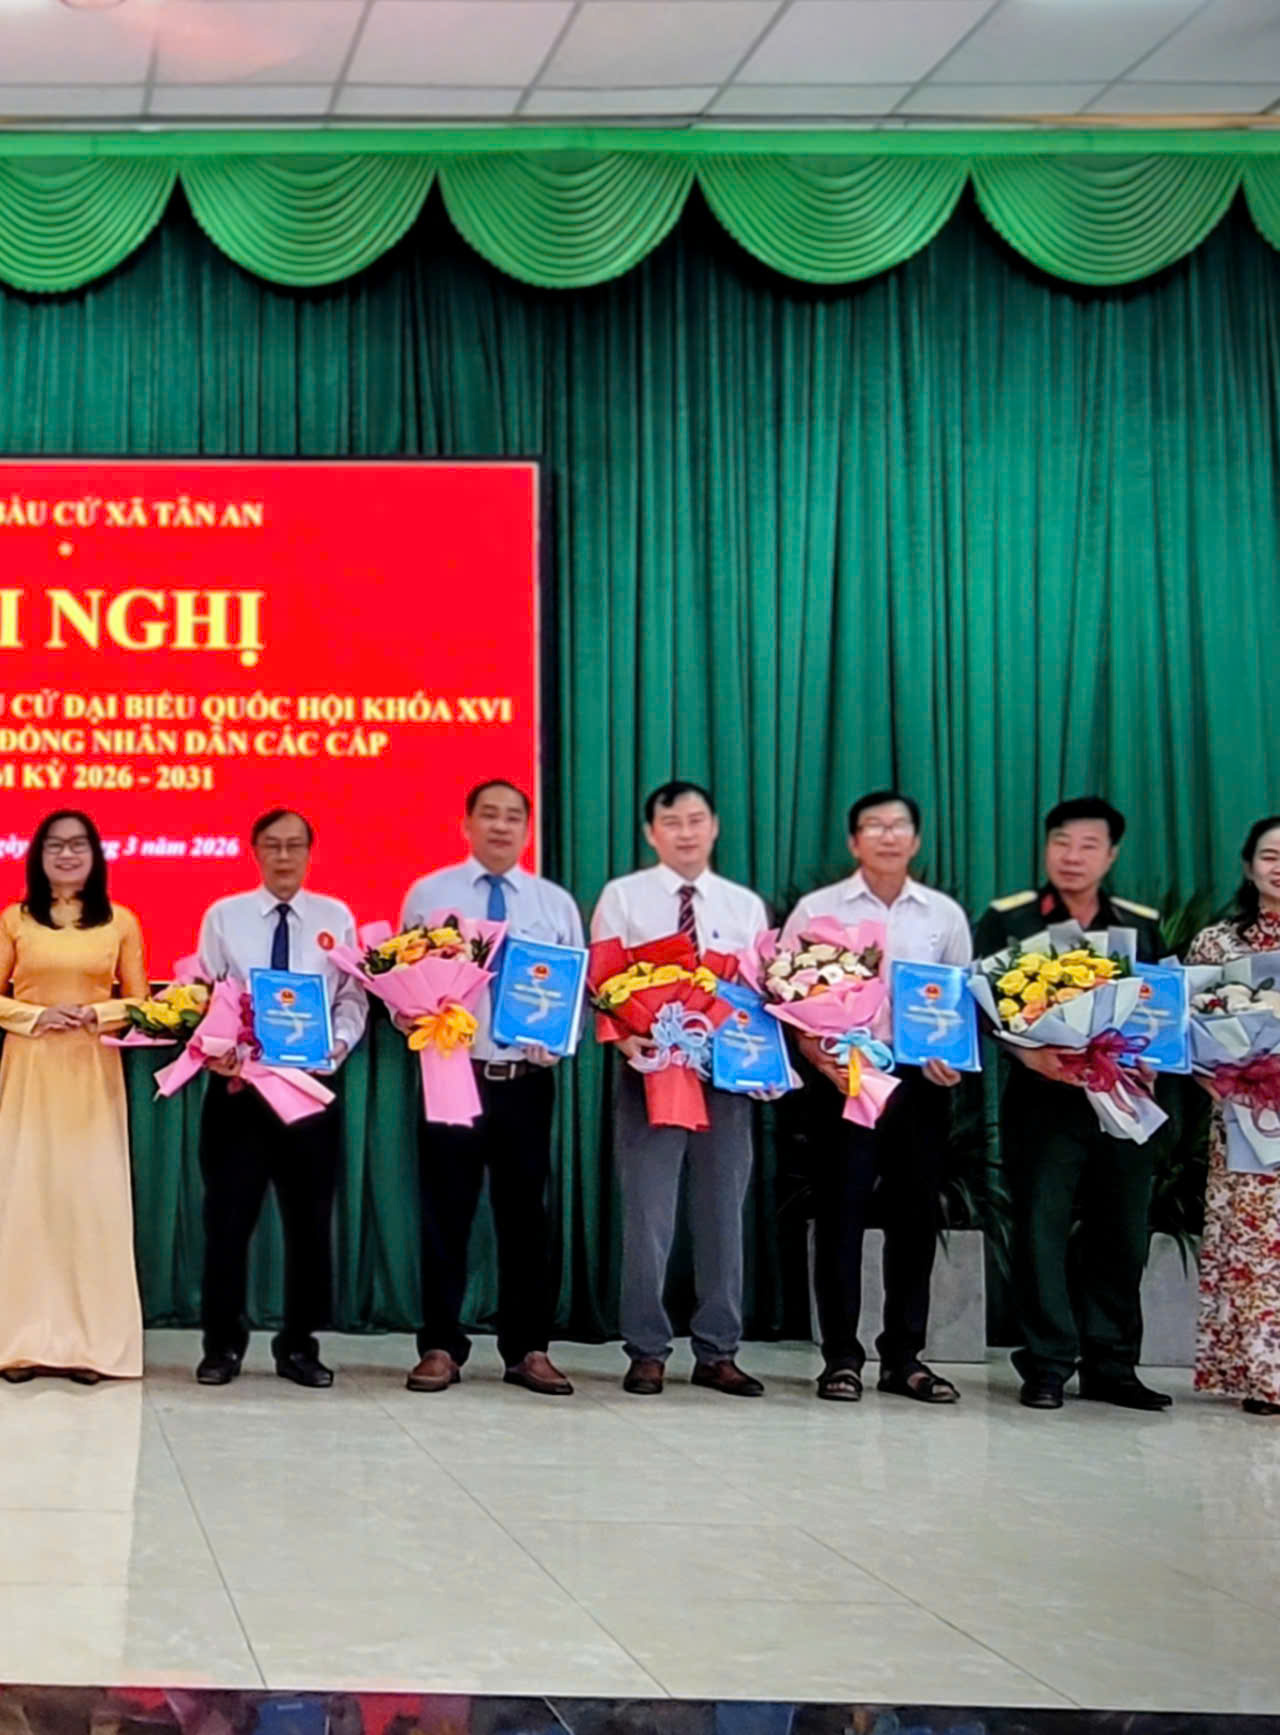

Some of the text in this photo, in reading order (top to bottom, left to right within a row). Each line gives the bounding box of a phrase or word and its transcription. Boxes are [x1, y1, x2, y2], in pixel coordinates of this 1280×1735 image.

[106, 496, 148, 527] XÃ
[153, 494, 216, 527] TÂN
[221, 502, 263, 527] AN
[45, 588, 264, 667] NGHỊ
[298, 693, 355, 726] HỘI
[363, 690, 453, 722] KHÓA
[458, 696, 511, 723] XVI
[92, 723, 177, 755] NHÂN
[185, 723, 248, 755] DÂN
[254, 724, 320, 756] CÁC
[73, 764, 133, 789] 2026
[156, 765, 214, 790] 2031
[191, 837, 239, 857] 2026
